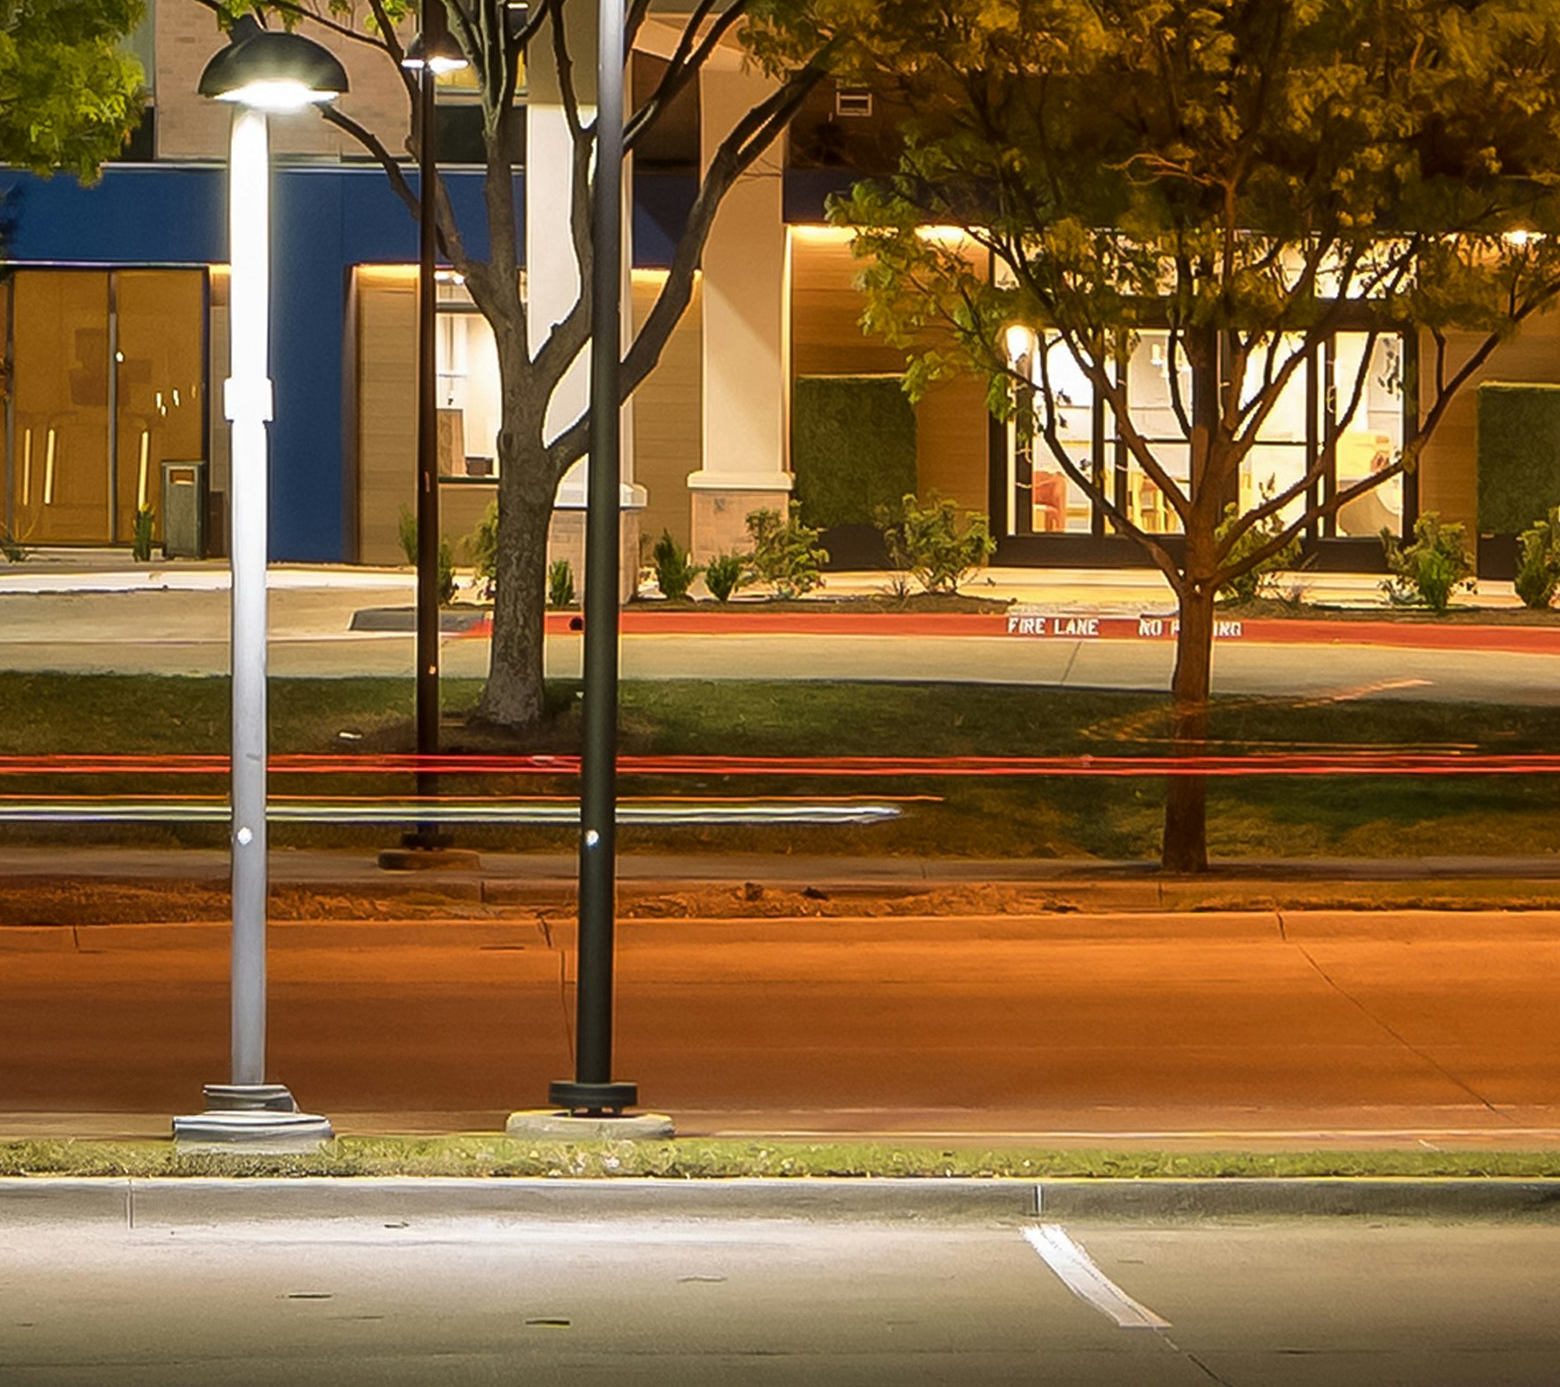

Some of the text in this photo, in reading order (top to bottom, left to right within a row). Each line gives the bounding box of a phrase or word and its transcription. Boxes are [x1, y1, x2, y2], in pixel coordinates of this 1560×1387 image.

[1007, 617, 1099, 636] FIRE LANE
[1138, 619, 1162, 636] NO
